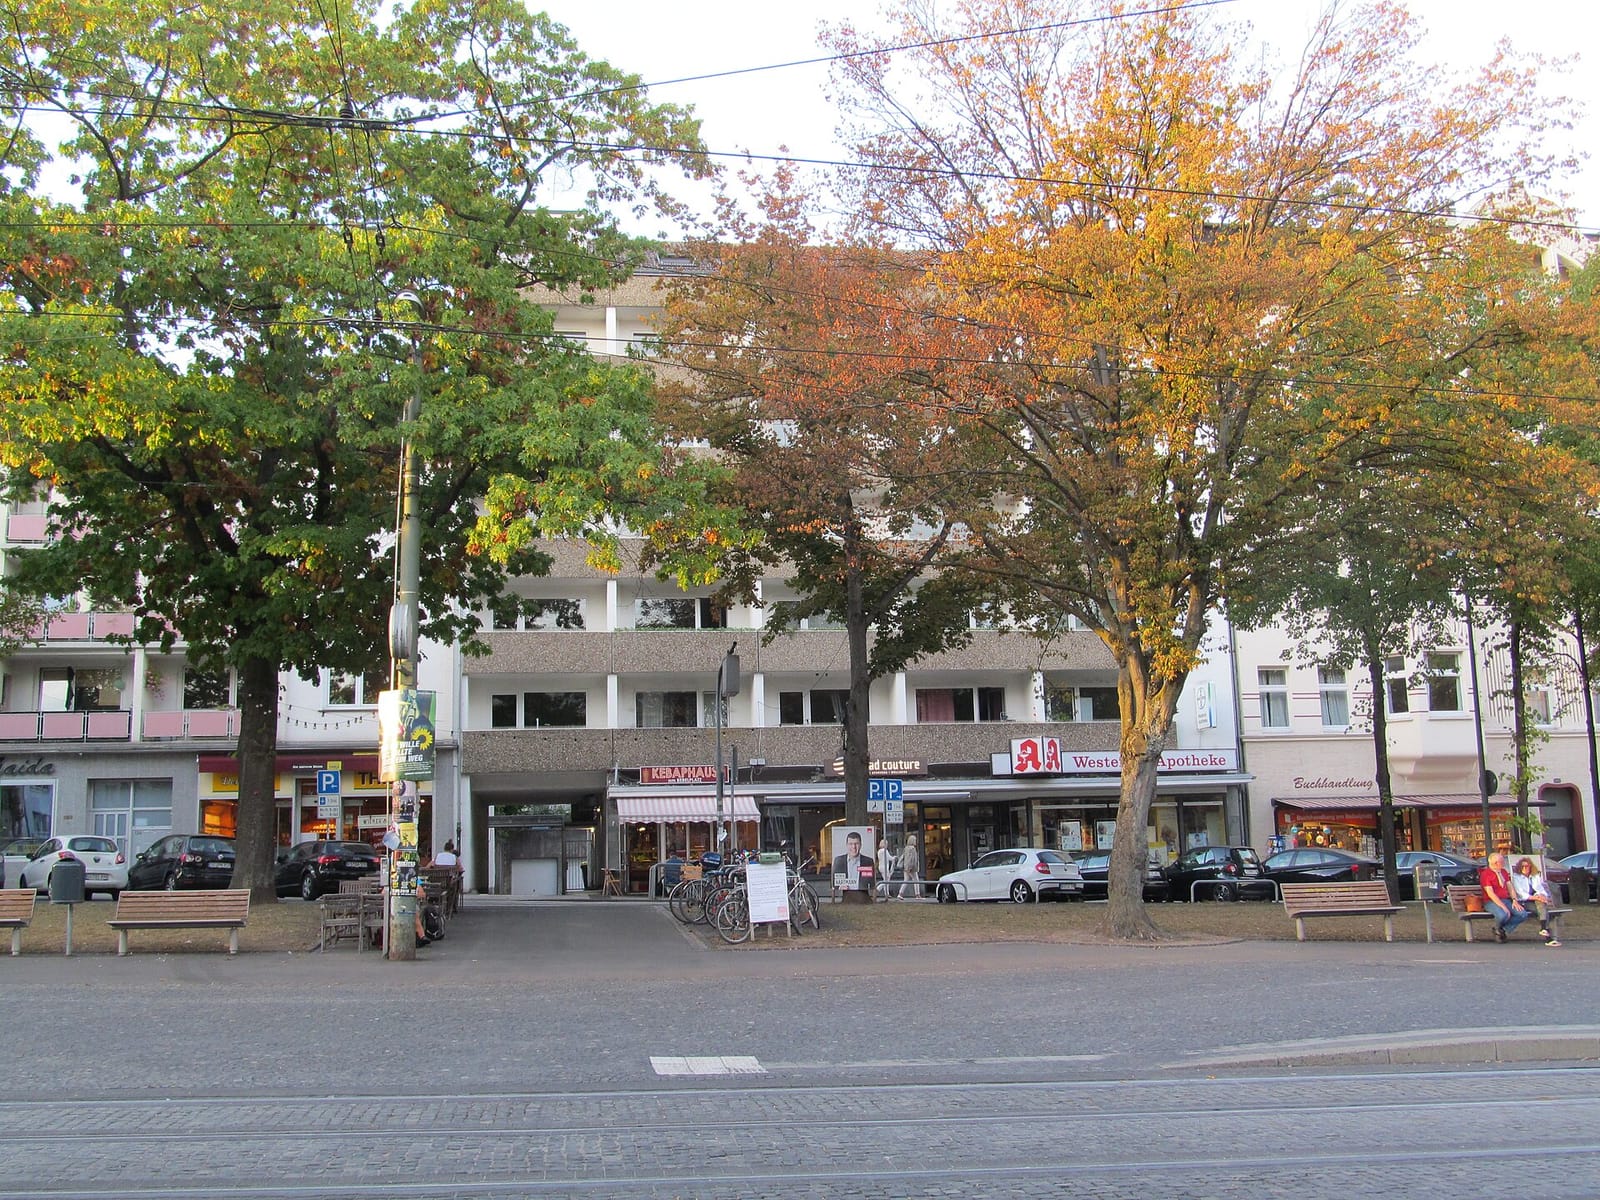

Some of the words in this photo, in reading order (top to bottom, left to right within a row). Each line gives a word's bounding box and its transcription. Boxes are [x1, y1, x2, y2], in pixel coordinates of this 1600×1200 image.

[408, 754, 424, 762] WEG
[1156, 755, 1226, 771] Apotheke
[652, 768, 717, 780] KEBAPHAUS
[882, 761, 921, 772] couture
[322, 773, 334, 792] P
[359, 772, 381, 785] TH
[1294, 776, 1374, 792] Buchhandlung
[869, 782, 880, 799] P
[889, 783, 899, 799] P
